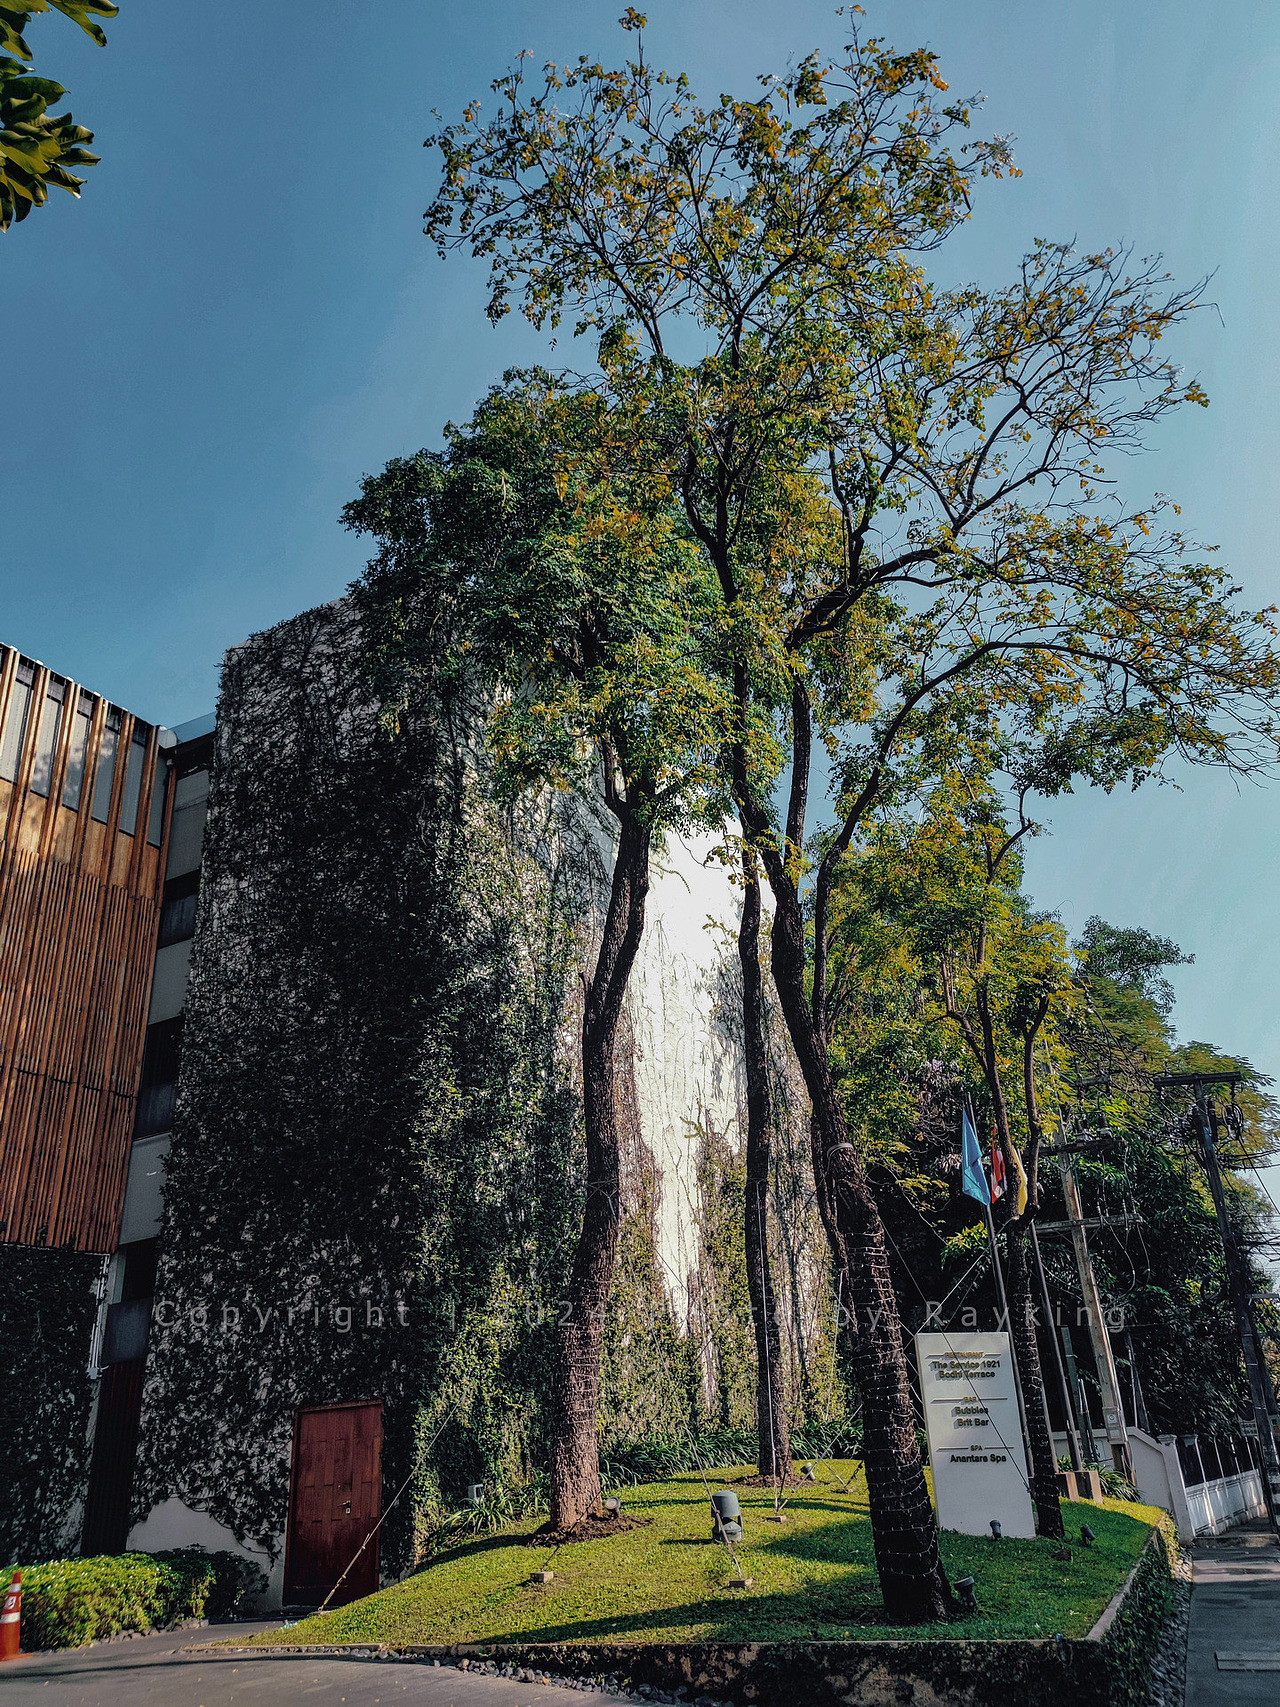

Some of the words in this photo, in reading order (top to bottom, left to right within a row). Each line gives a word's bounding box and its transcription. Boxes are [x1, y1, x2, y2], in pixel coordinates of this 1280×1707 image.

[932, 1361, 948, 1369] The
[951, 1360, 980, 1369] Service
[982, 1360, 1001, 1368] 1921
[939, 1370, 963, 1379] Bodhi
[965, 1370, 996, 1378] Terrace
[955, 1406, 989, 1415] Bubbles
[957, 1418, 973, 1427] Brit
[974, 1418, 989, 1427] Bar
[950, 1454, 988, 1463] Anantara
[990, 1454, 1007, 1464] Spa
